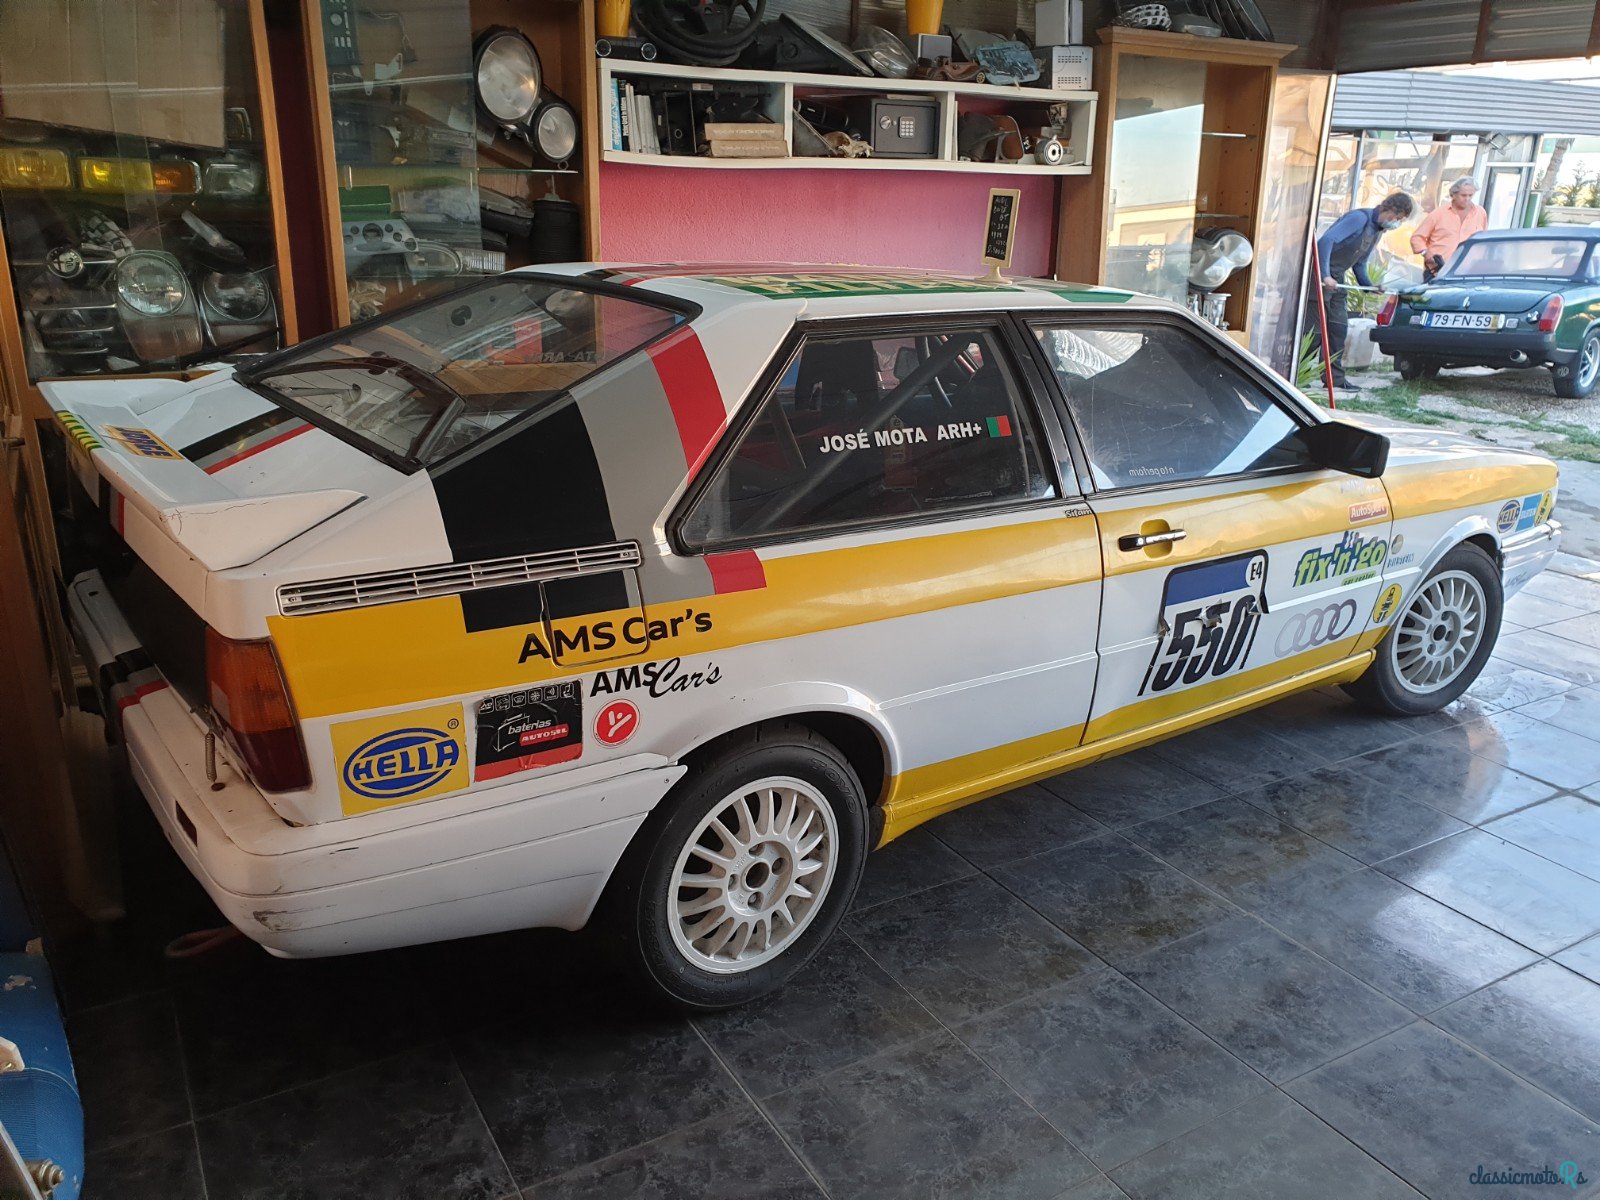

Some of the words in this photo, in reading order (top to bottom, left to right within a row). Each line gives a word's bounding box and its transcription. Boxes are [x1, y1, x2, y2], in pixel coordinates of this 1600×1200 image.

[819, 429, 870, 453] JOSÉ
[875, 427, 927, 447] MOTA
[937, 422, 982, 441] ARH+
[1065, 509, 1092, 518] Sifam
[1498, 506, 1520, 523] HELLA
[1250, 561, 1263, 581] E4
[518, 620, 617, 664] AMS
[622, 608, 713, 645] Car's
[1152, 595, 1255, 692] 550
[508, 719, 552, 735] baterias
[352, 738, 460, 781] HELLA
[809, 758, 857, 814] TOYO
